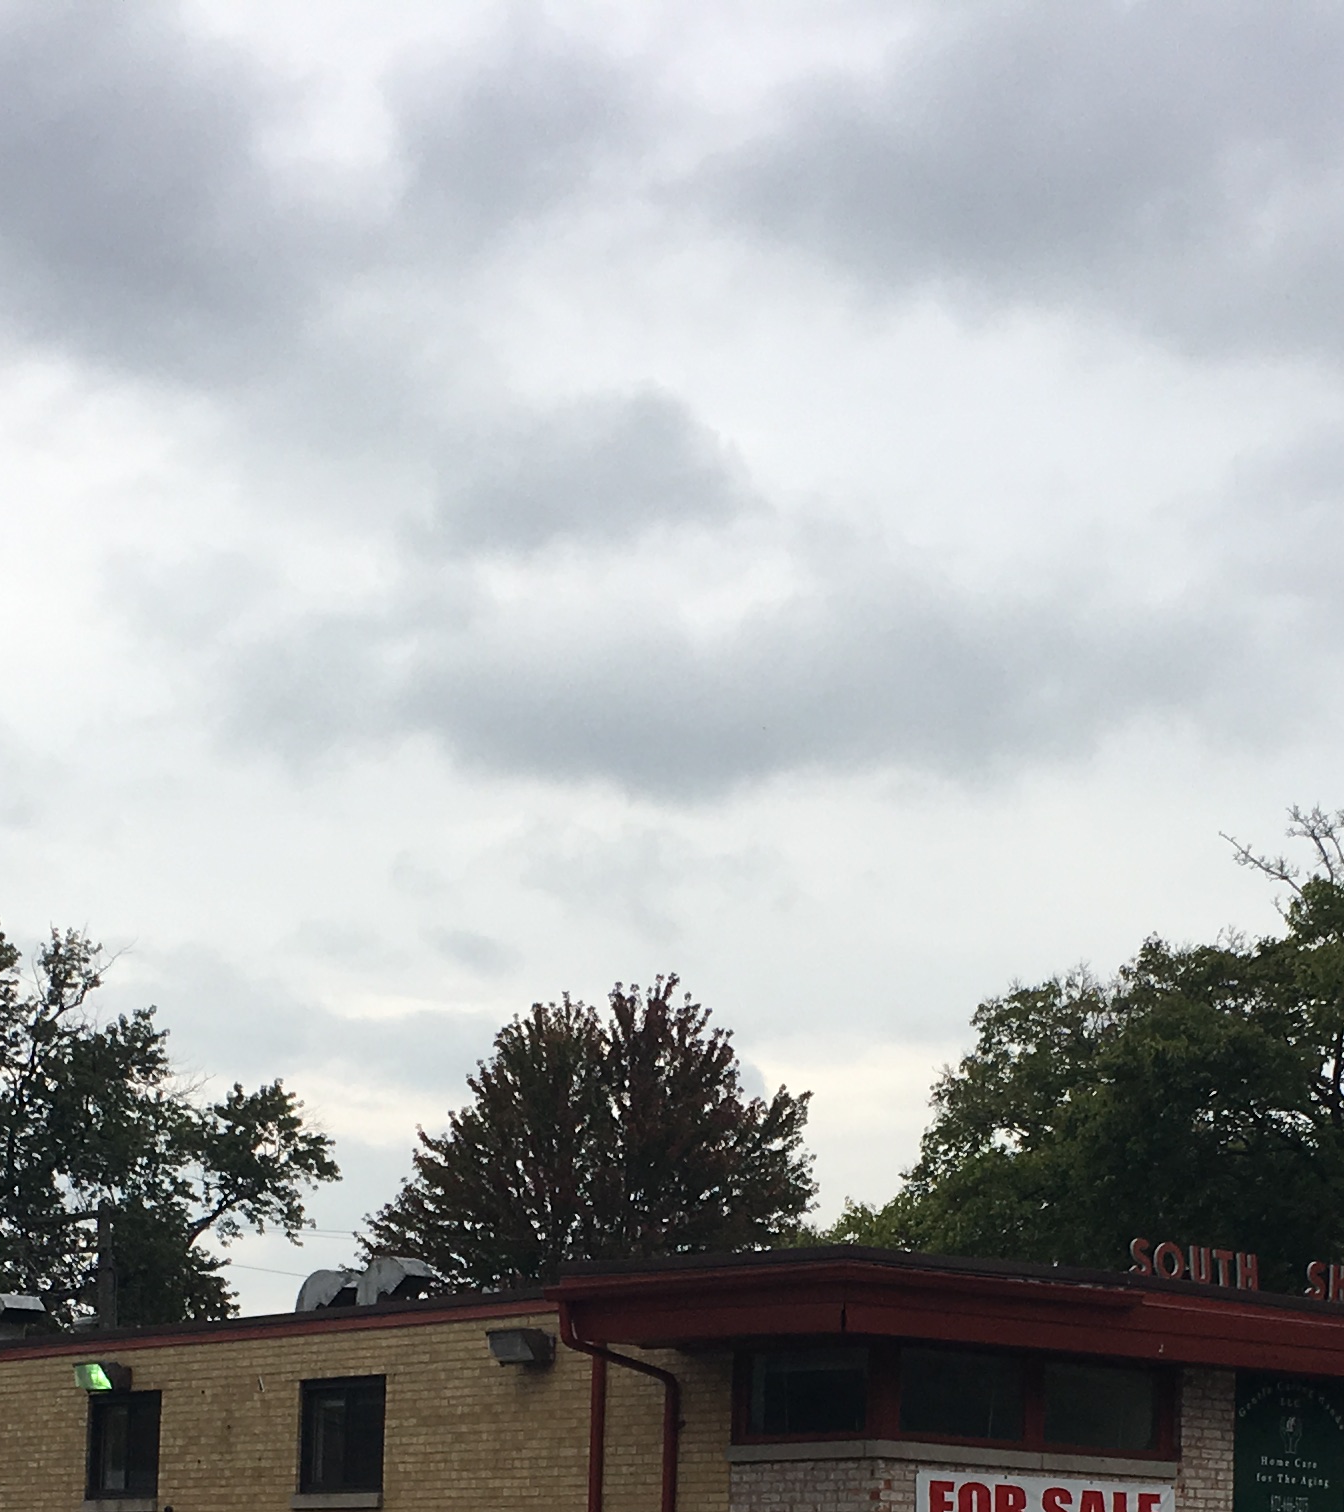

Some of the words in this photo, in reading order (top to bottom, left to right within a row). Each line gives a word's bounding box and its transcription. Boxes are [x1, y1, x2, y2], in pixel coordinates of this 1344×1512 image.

[1130, 1237, 1257, 1289] SOUTH
[1261, 1456, 1290, 1467] Home
[1294, 1458, 1318, 1469] Care
[1277, 1474, 1297, 1484] The
[1300, 1477, 1330, 1489] Aging
